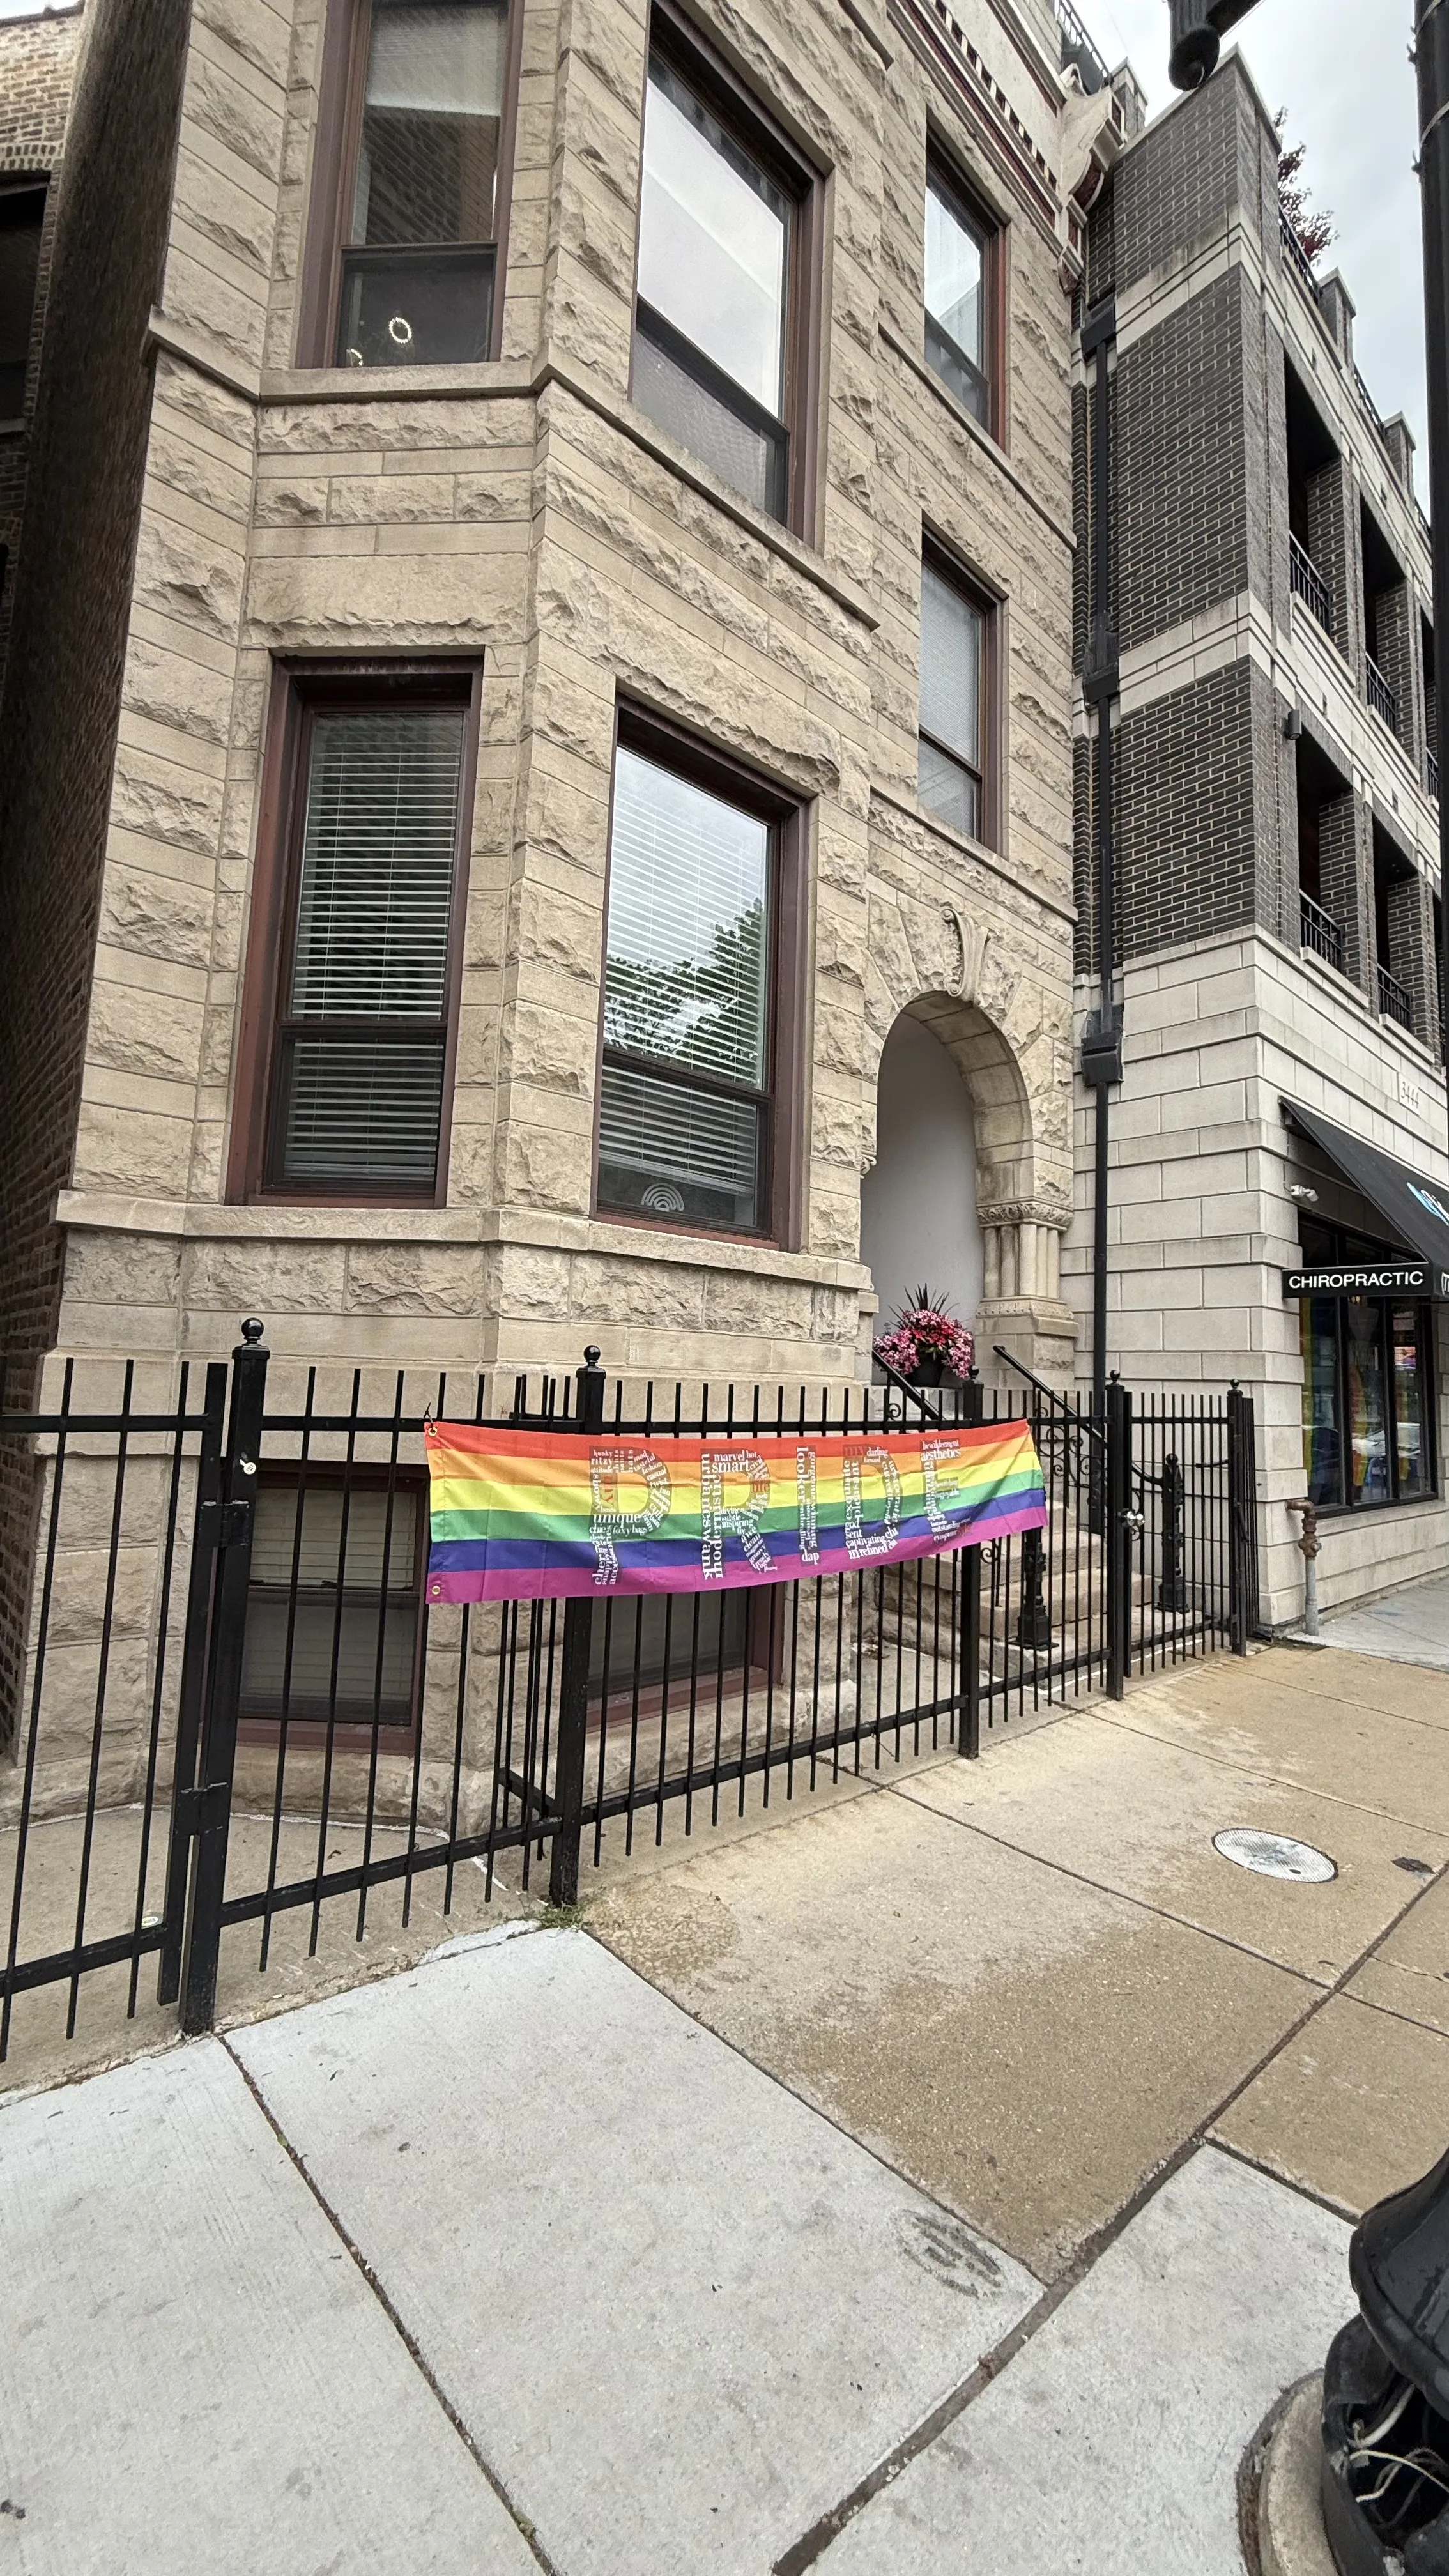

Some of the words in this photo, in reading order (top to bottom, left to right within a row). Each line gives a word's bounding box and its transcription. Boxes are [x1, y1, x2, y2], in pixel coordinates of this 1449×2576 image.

[1289, 1271, 1423, 1289] CHIROPRACTIC
[713, 1449, 745, 1462] marvel
[920, 1447, 962, 1462] aesthetics
[590, 1457, 613, 1468] ritzy
[711, 1459, 751, 1473] smart
[797, 1446, 809, 1504] looker
[593, 1514, 641, 1528] unique
[809, 1503, 818, 1548] winning
[631, 1524, 648, 1536] bags
